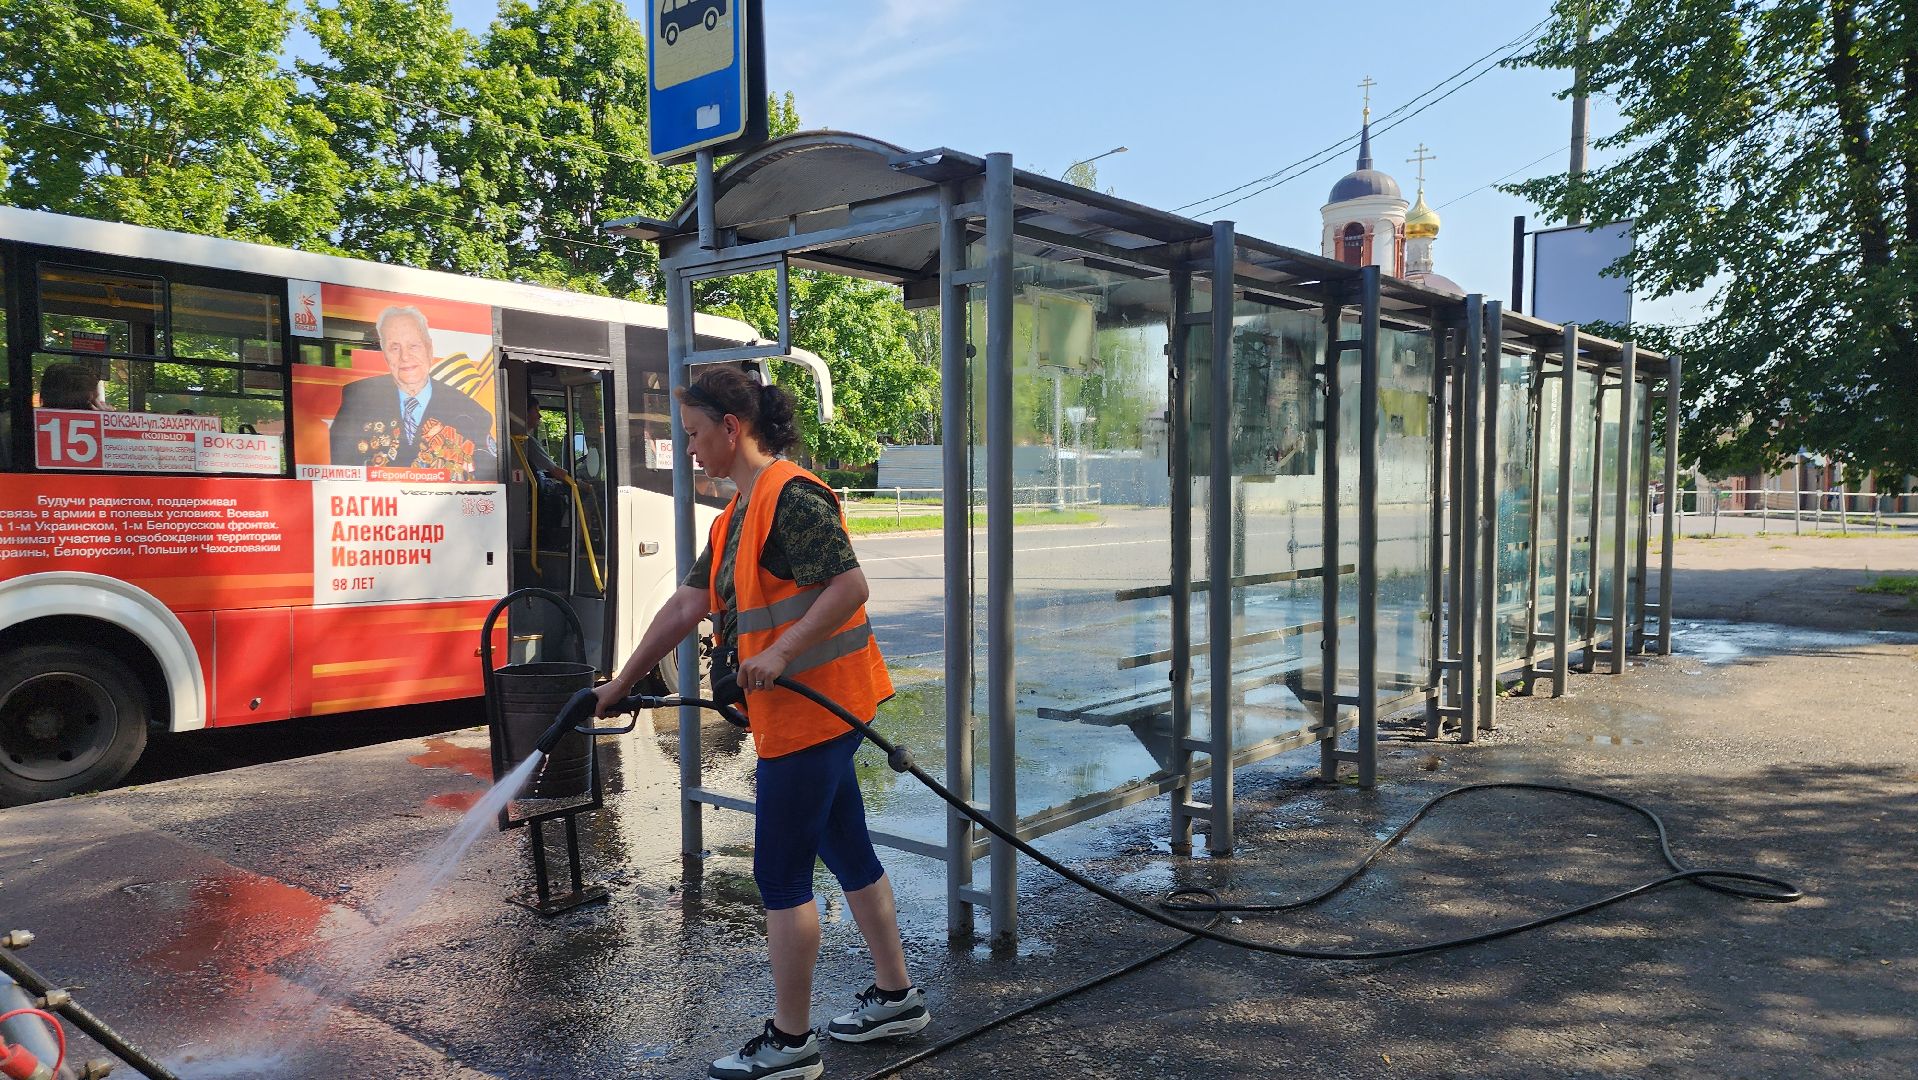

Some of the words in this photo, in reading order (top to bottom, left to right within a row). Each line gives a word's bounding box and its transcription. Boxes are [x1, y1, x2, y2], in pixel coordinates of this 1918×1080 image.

[39, 418, 98, 463] 15
[141, 432, 187, 442] (КОЛЬЦО)
[203, 436, 267, 451] ВОКЗАЛ
[302, 467, 361, 479] ГОРДИМСЯ!
[370, 470, 445, 481] #ГероиГородаС
[37, 495, 86, 508] Будучи
[89, 497, 154, 508] радистом,
[156, 498, 238, 508] поддерживал
[330, 495, 398, 517] ВАГИН
[0, 510, 37, 519] связь
[41, 510, 50, 518] в
[53, 510, 96, 521] армии
[98, 510, 107, 518] в
[110, 510, 164, 519] полевых
[166, 509, 224, 521] условиях.
[227, 508, 269, 518] Воевал
[8, 521, 31, 531] 1-м
[34, 520, 118, 534] Украинском,
[122, 520, 143, 531] 1-м
[146, 520, 225, 533] Белорусском
[227, 520, 280, 532] фронтах.
[331, 520, 445, 544] Александр
[58, 534, 112, 546] участие
[125, 532, 214, 544] освобождении
[216, 532, 282, 544] территории
[0, 549, 50, 560] раины,
[53, 545, 136, 558] Белоруссии,
[139, 543, 188, 555] Польши
[190, 545, 198, 554] и
[200, 542, 281, 554] Чехословакии
[331, 545, 432, 568] Иванович
[332, 578, 348, 591] 98
[351, 576, 375, 591] ЛЕТ
